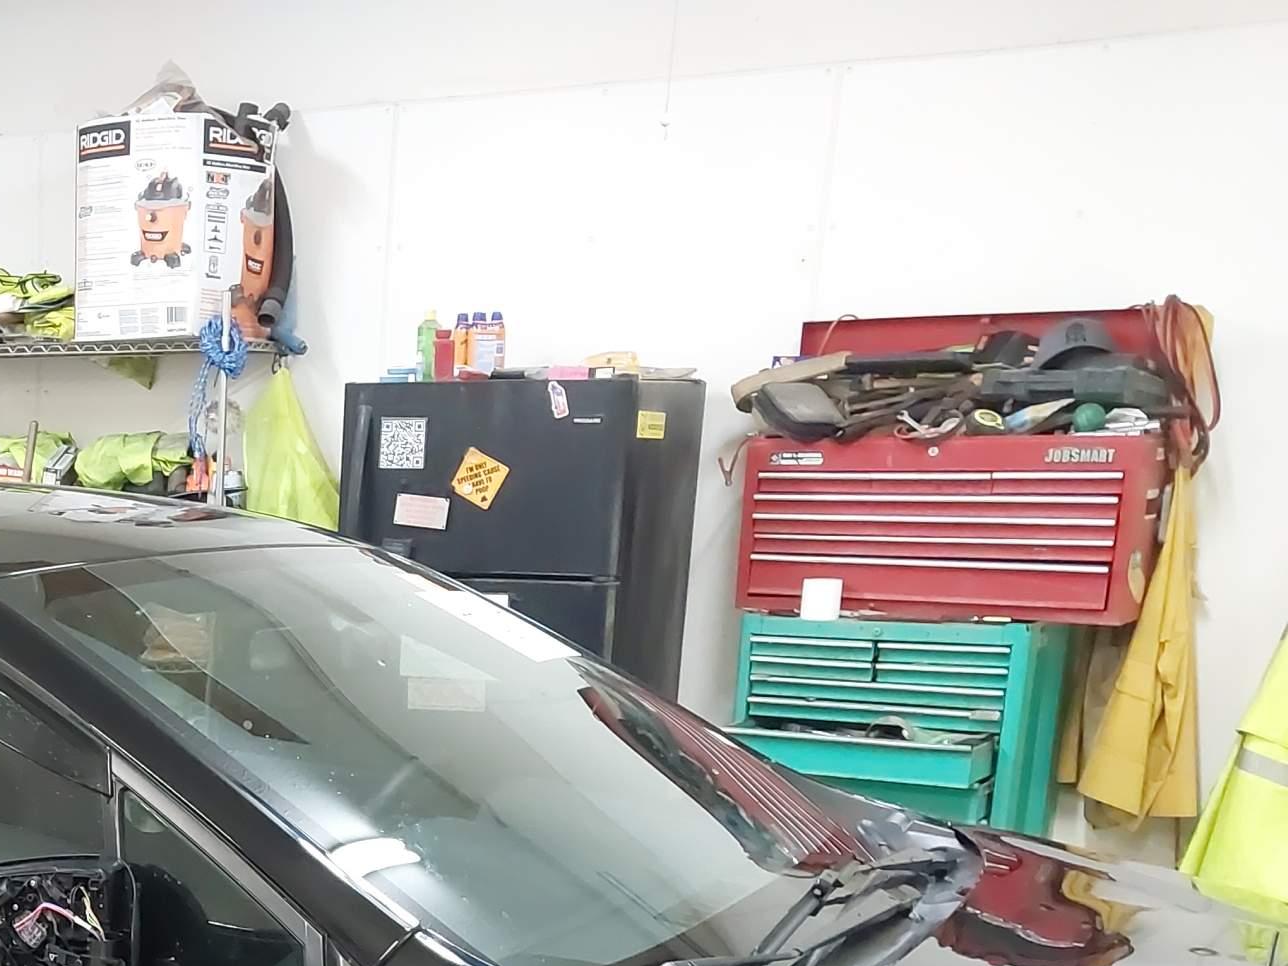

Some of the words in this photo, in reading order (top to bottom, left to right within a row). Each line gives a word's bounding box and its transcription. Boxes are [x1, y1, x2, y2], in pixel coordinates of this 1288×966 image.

[80, 129, 125, 149] RIDGID
[1044, 447, 1116, 463] JOBSMART
[475, 462, 487, 471] ONLY
[457, 471, 482, 485] SPEEDING
